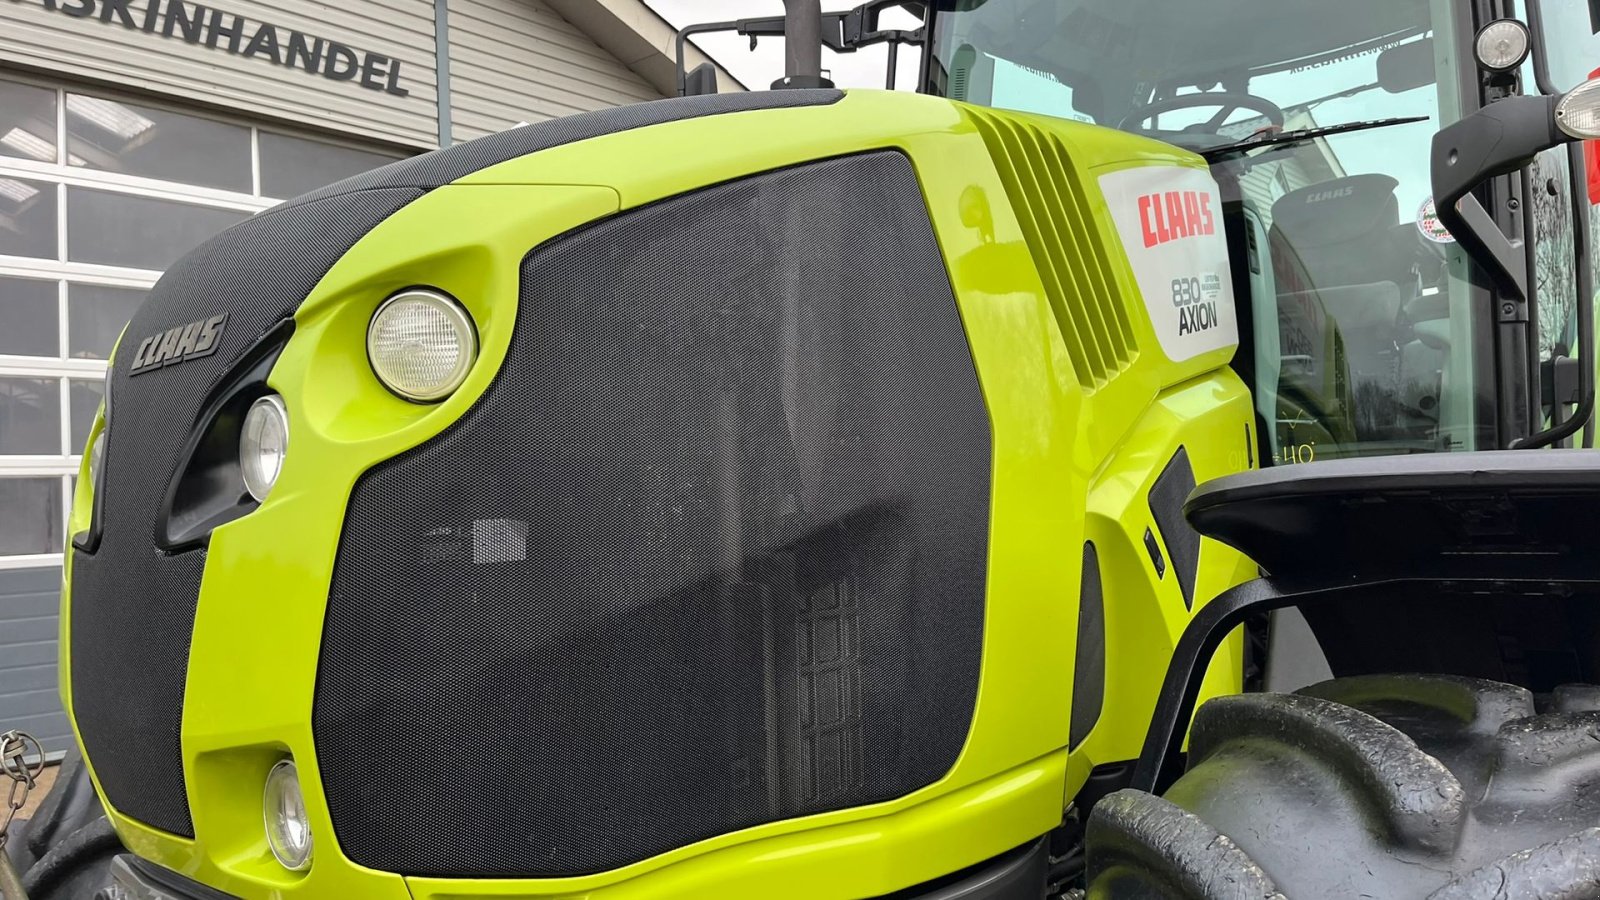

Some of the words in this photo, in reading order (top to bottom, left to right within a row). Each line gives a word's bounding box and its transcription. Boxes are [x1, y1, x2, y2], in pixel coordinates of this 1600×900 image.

[7, 0, 410, 97] SKINHANDEL
[1306, 186, 1353, 203] CLAAS
[1138, 191, 1214, 248] CLAAS
[1172, 277, 1201, 307] 830
[1179, 301, 1218, 336] AXION
[130, 314, 228, 375] CLAAS
